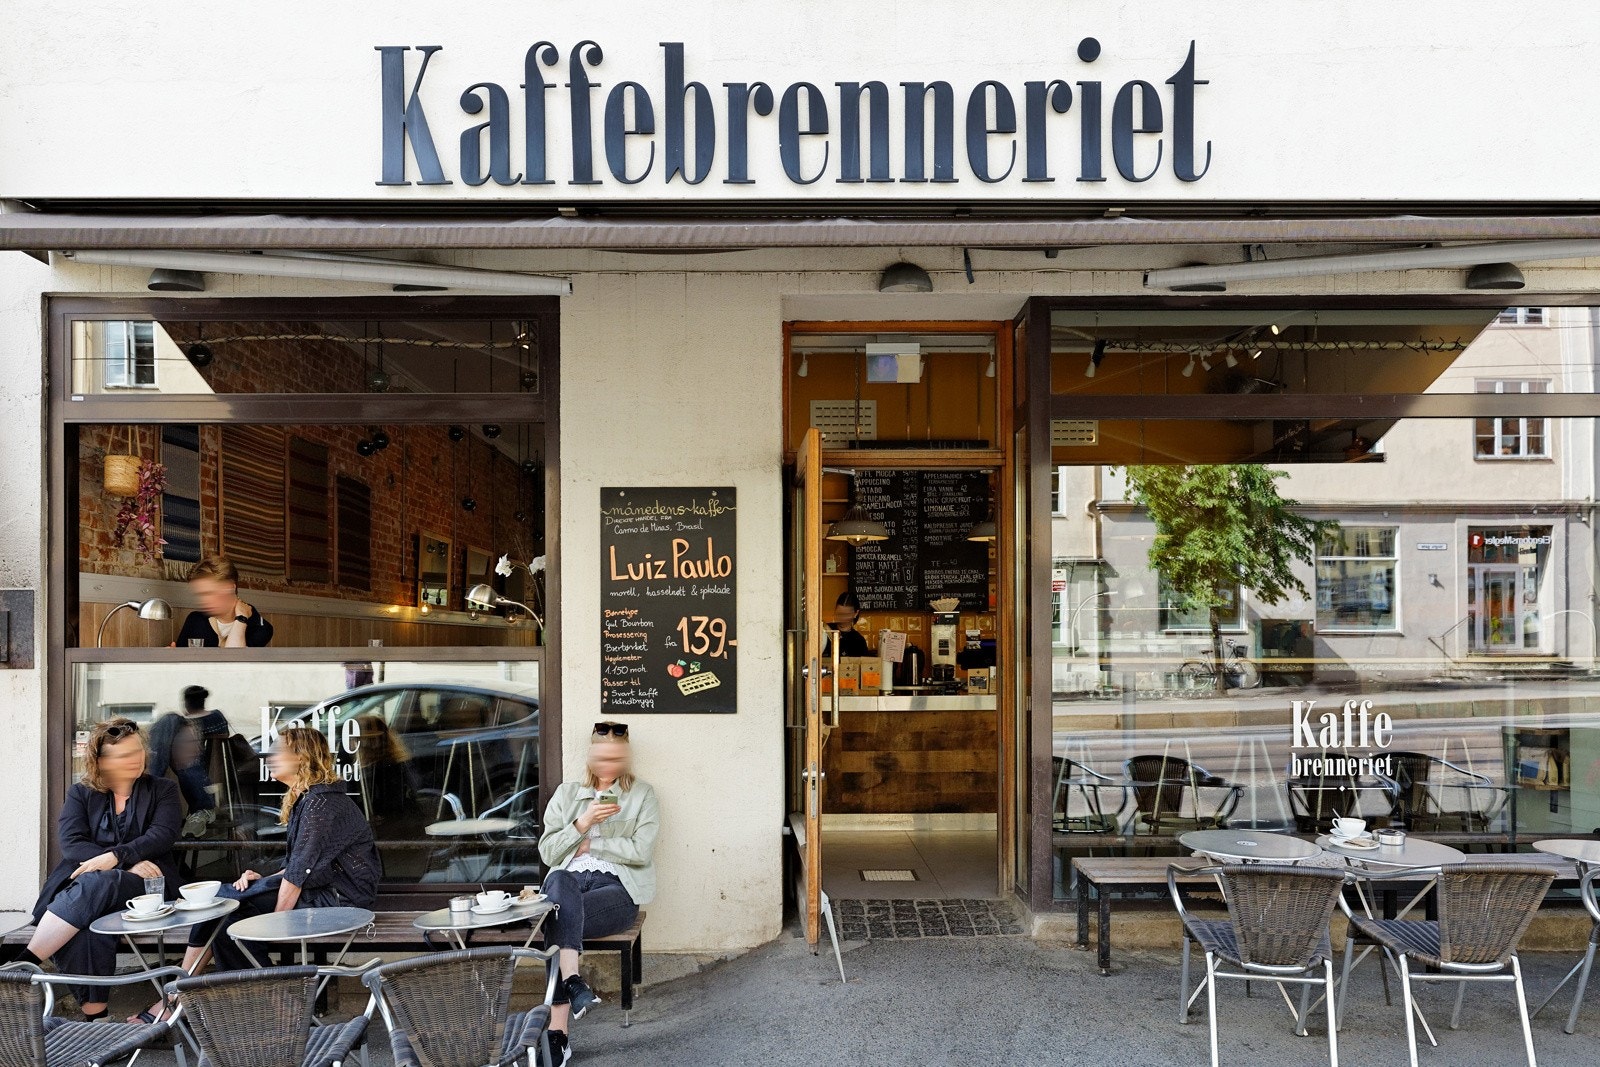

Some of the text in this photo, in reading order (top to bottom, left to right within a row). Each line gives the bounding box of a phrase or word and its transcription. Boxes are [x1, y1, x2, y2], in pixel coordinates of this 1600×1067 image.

[374, 37, 1212, 187] Kaffebrenneriet
[639, 526, 650, 534] de
[675, 518, 704, 532] Brasil
[609, 536, 732, 581] Luiz Paulo
[690, 584, 699, 596] &
[620, 617, 655, 629] Bourbon
[664, 635, 678, 649] fra
[602, 677, 641, 687] Passer til
[611, 687, 660, 699] Svart kaffe
[1291, 699, 1393, 749] Kaffe
[1291, 752, 1393, 777] brenneriet
